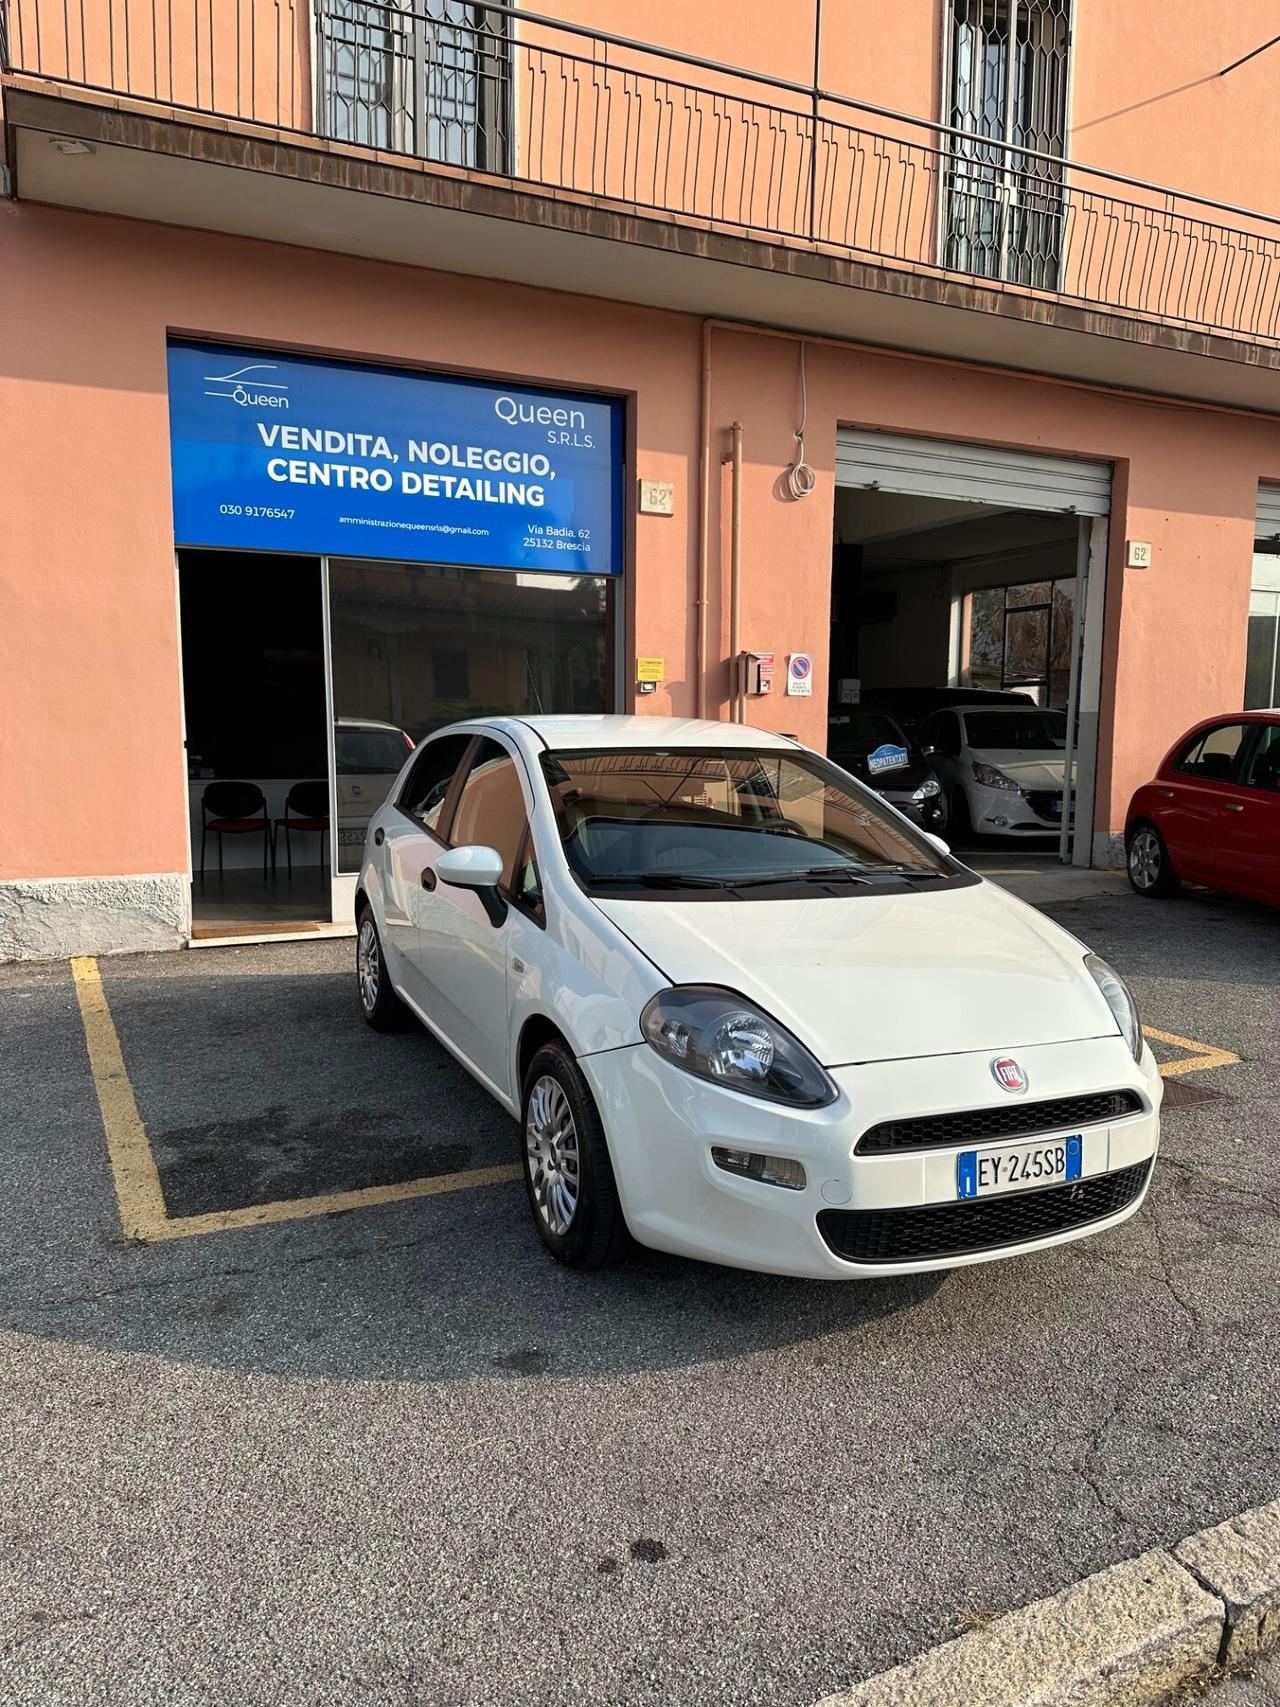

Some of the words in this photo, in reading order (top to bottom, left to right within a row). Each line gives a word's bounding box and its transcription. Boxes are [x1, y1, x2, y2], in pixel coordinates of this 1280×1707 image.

[233, 389, 289, 408] Queen
[495, 396, 585, 430] Queen
[547, 430, 596, 449] S.R.L.S.
[257, 422, 400, 464] VENDITA,
[408, 439, 556, 481] NOLEGGIO,
[267, 457, 393, 492] CENTRO
[401, 471, 545, 507] DETAILING
[219, 504, 243, 515] 030
[245, 506, 295, 519] 9176547
[338, 516, 490, 536] amministrazionequeensrls@gmail.com
[527, 524, 543, 535] Via
[546, 526, 576, 539] Badia,
[578, 529, 591, 539] 62
[523, 537, 554, 549] 25132
[556, 540, 591, 552] Brescia
[1134, 547, 1147, 561] 62
